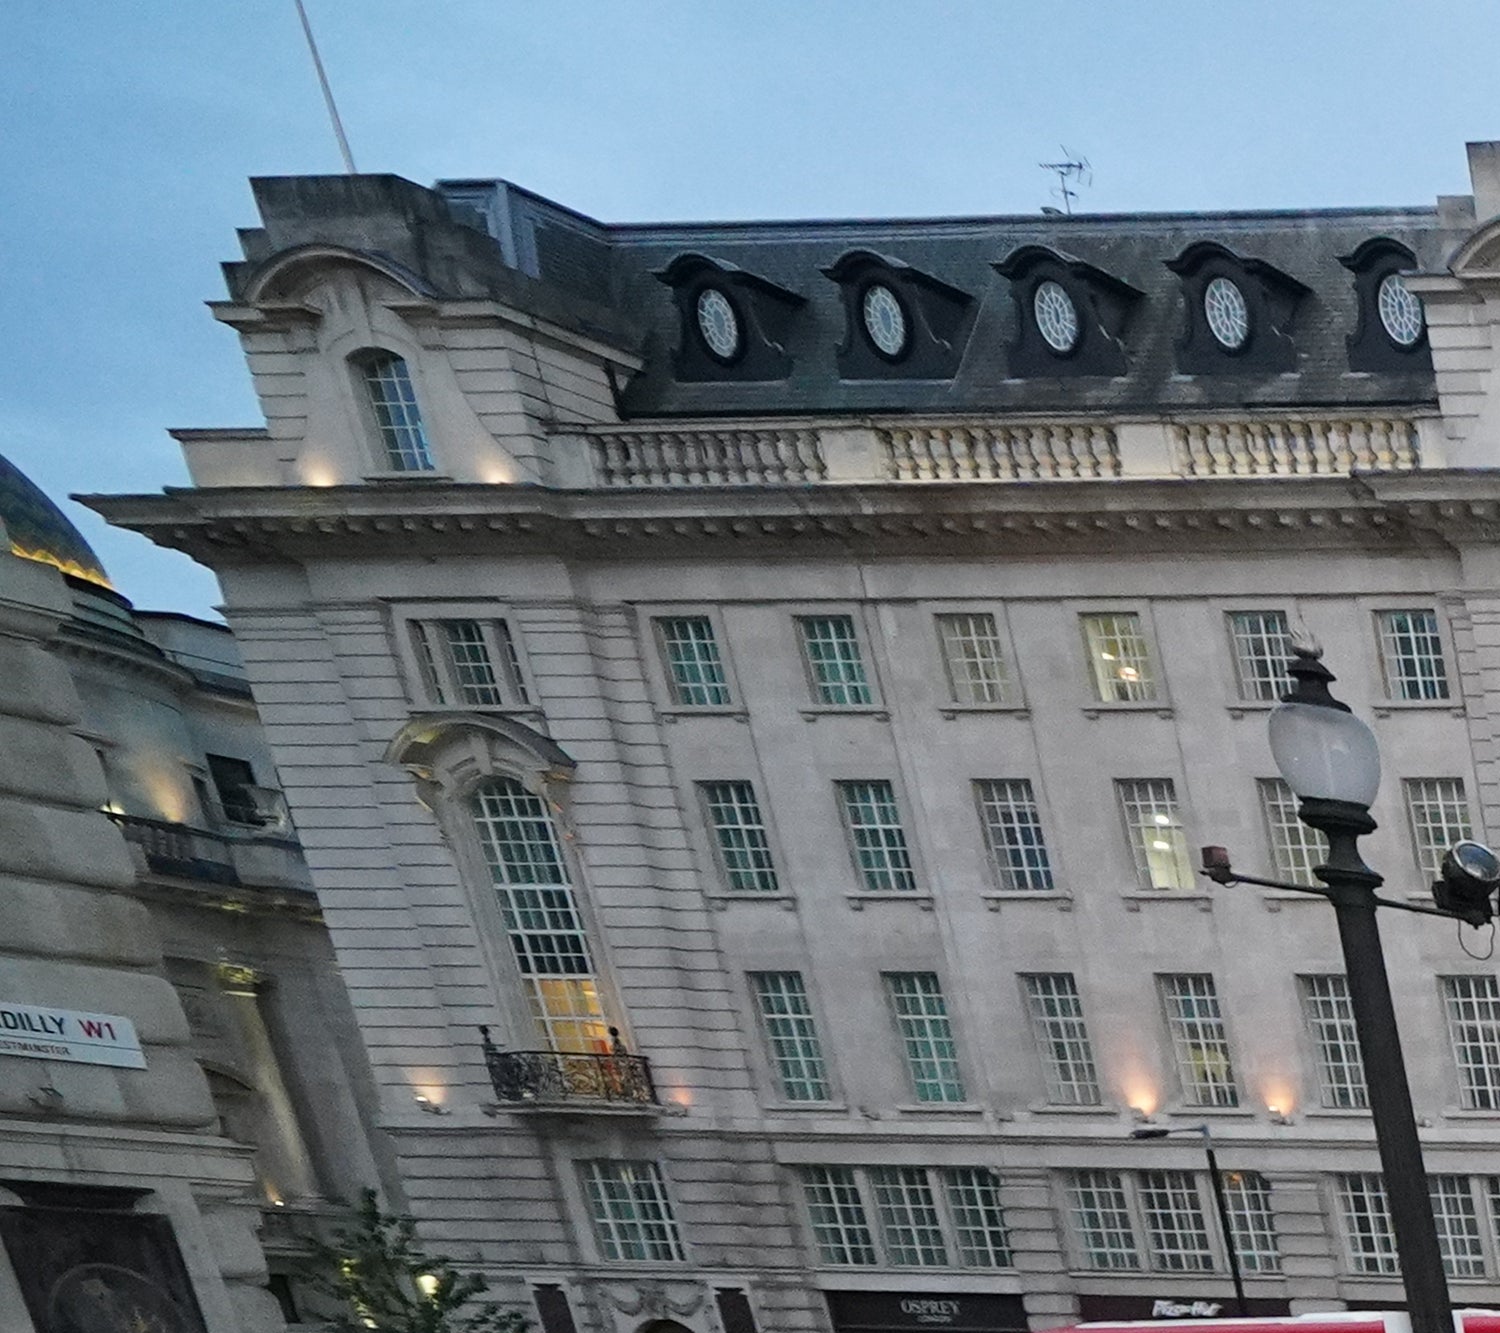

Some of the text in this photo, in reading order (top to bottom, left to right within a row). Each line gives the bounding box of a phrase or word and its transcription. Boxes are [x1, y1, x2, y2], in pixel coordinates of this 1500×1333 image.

[0, 1010, 117, 1041] DILLY W1
[0, 1040, 71, 1055] STMINSTER
[900, 1299, 960, 1314] OSPREY
